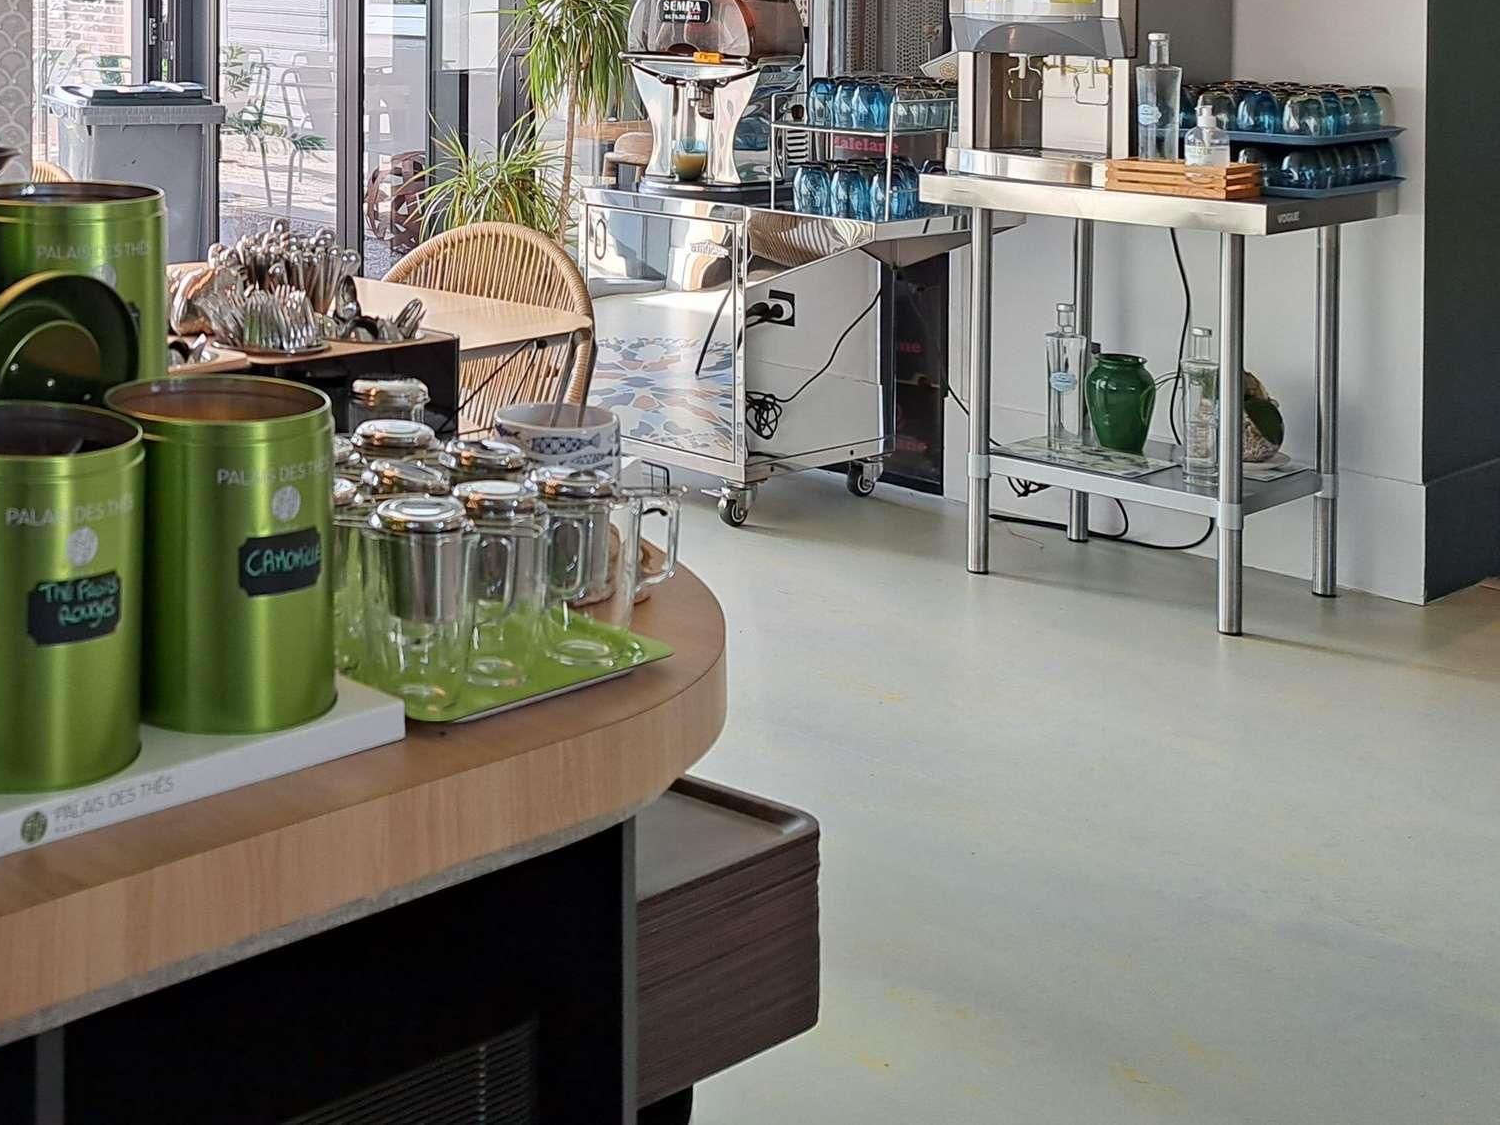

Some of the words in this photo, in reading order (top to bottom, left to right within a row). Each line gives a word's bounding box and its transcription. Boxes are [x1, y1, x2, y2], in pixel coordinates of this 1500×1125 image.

[663, 0, 701, 12] SEMPA
[53, 794, 104, 821] PALAIS
[108, 786, 136, 809] DES
